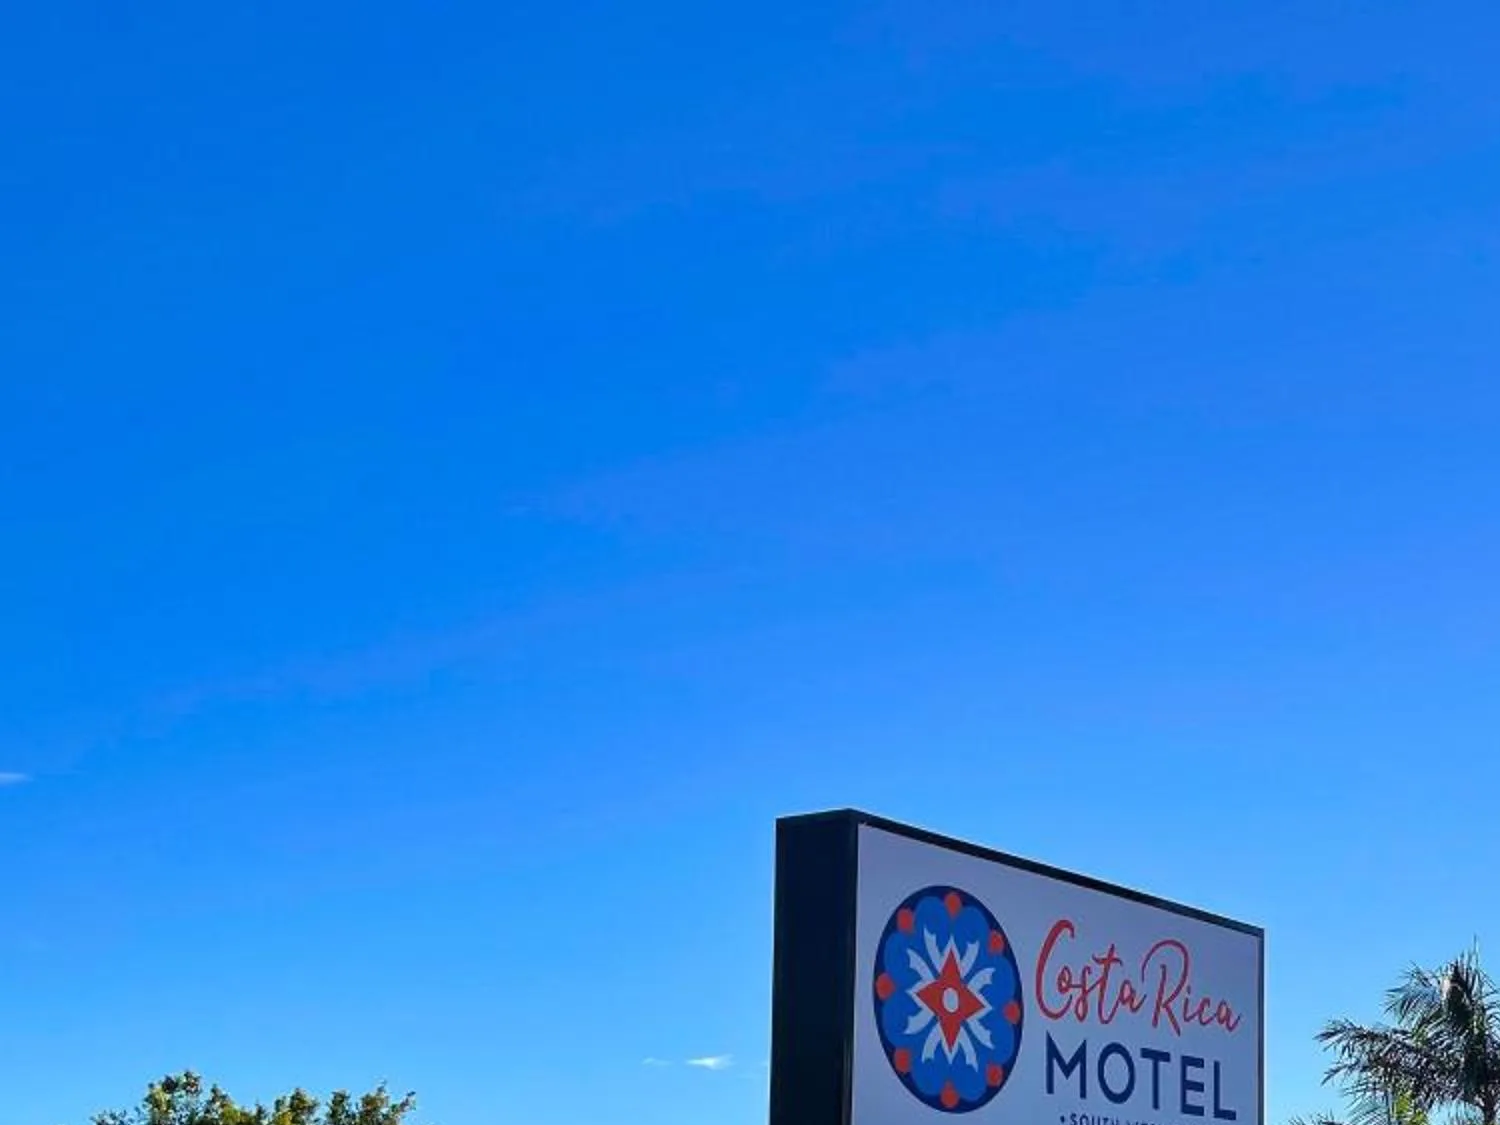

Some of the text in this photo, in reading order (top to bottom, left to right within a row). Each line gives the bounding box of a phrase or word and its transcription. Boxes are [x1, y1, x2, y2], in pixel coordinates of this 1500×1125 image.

[1036, 920, 1241, 1037] Costa Rica
[1046, 1031, 1238, 1121] MOTEL
